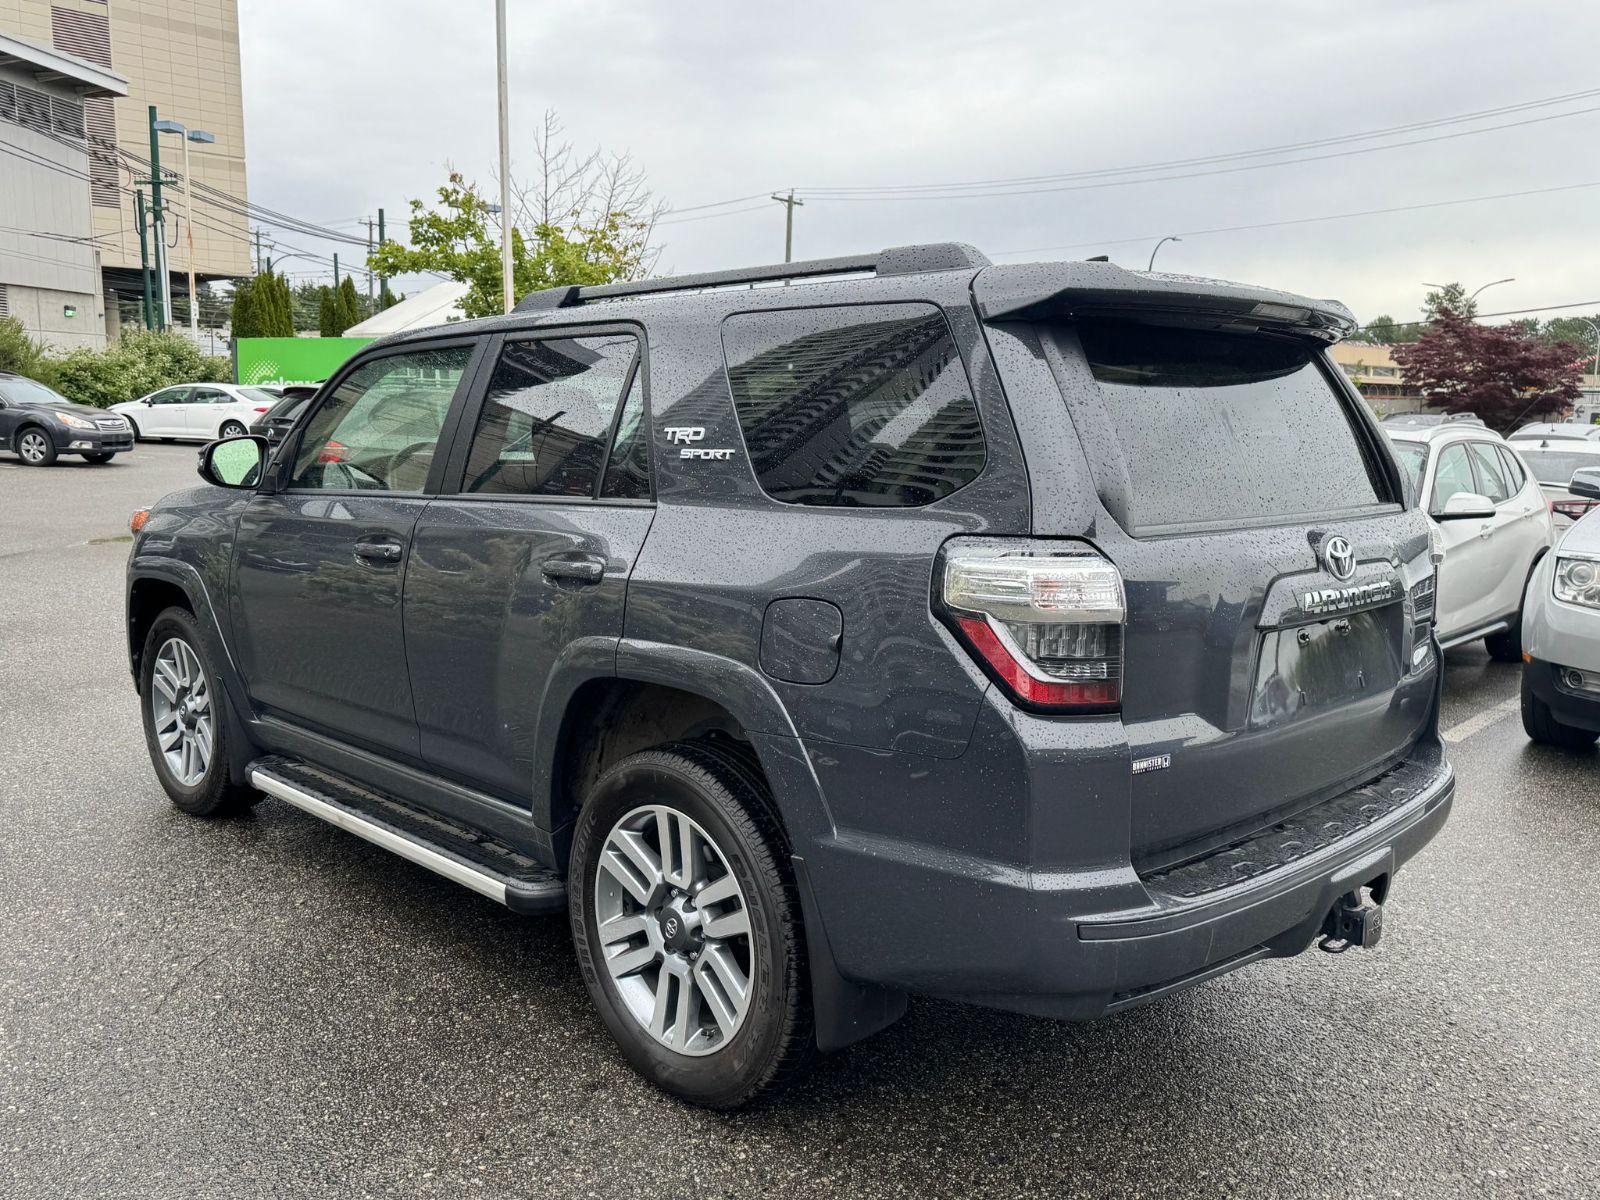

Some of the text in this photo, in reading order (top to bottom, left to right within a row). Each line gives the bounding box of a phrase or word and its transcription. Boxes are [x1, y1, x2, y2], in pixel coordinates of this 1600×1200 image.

[664, 427, 706, 444] TRD
[680, 449, 735, 460] SPORT
[1304, 581, 1392, 613] 4RUNNER
